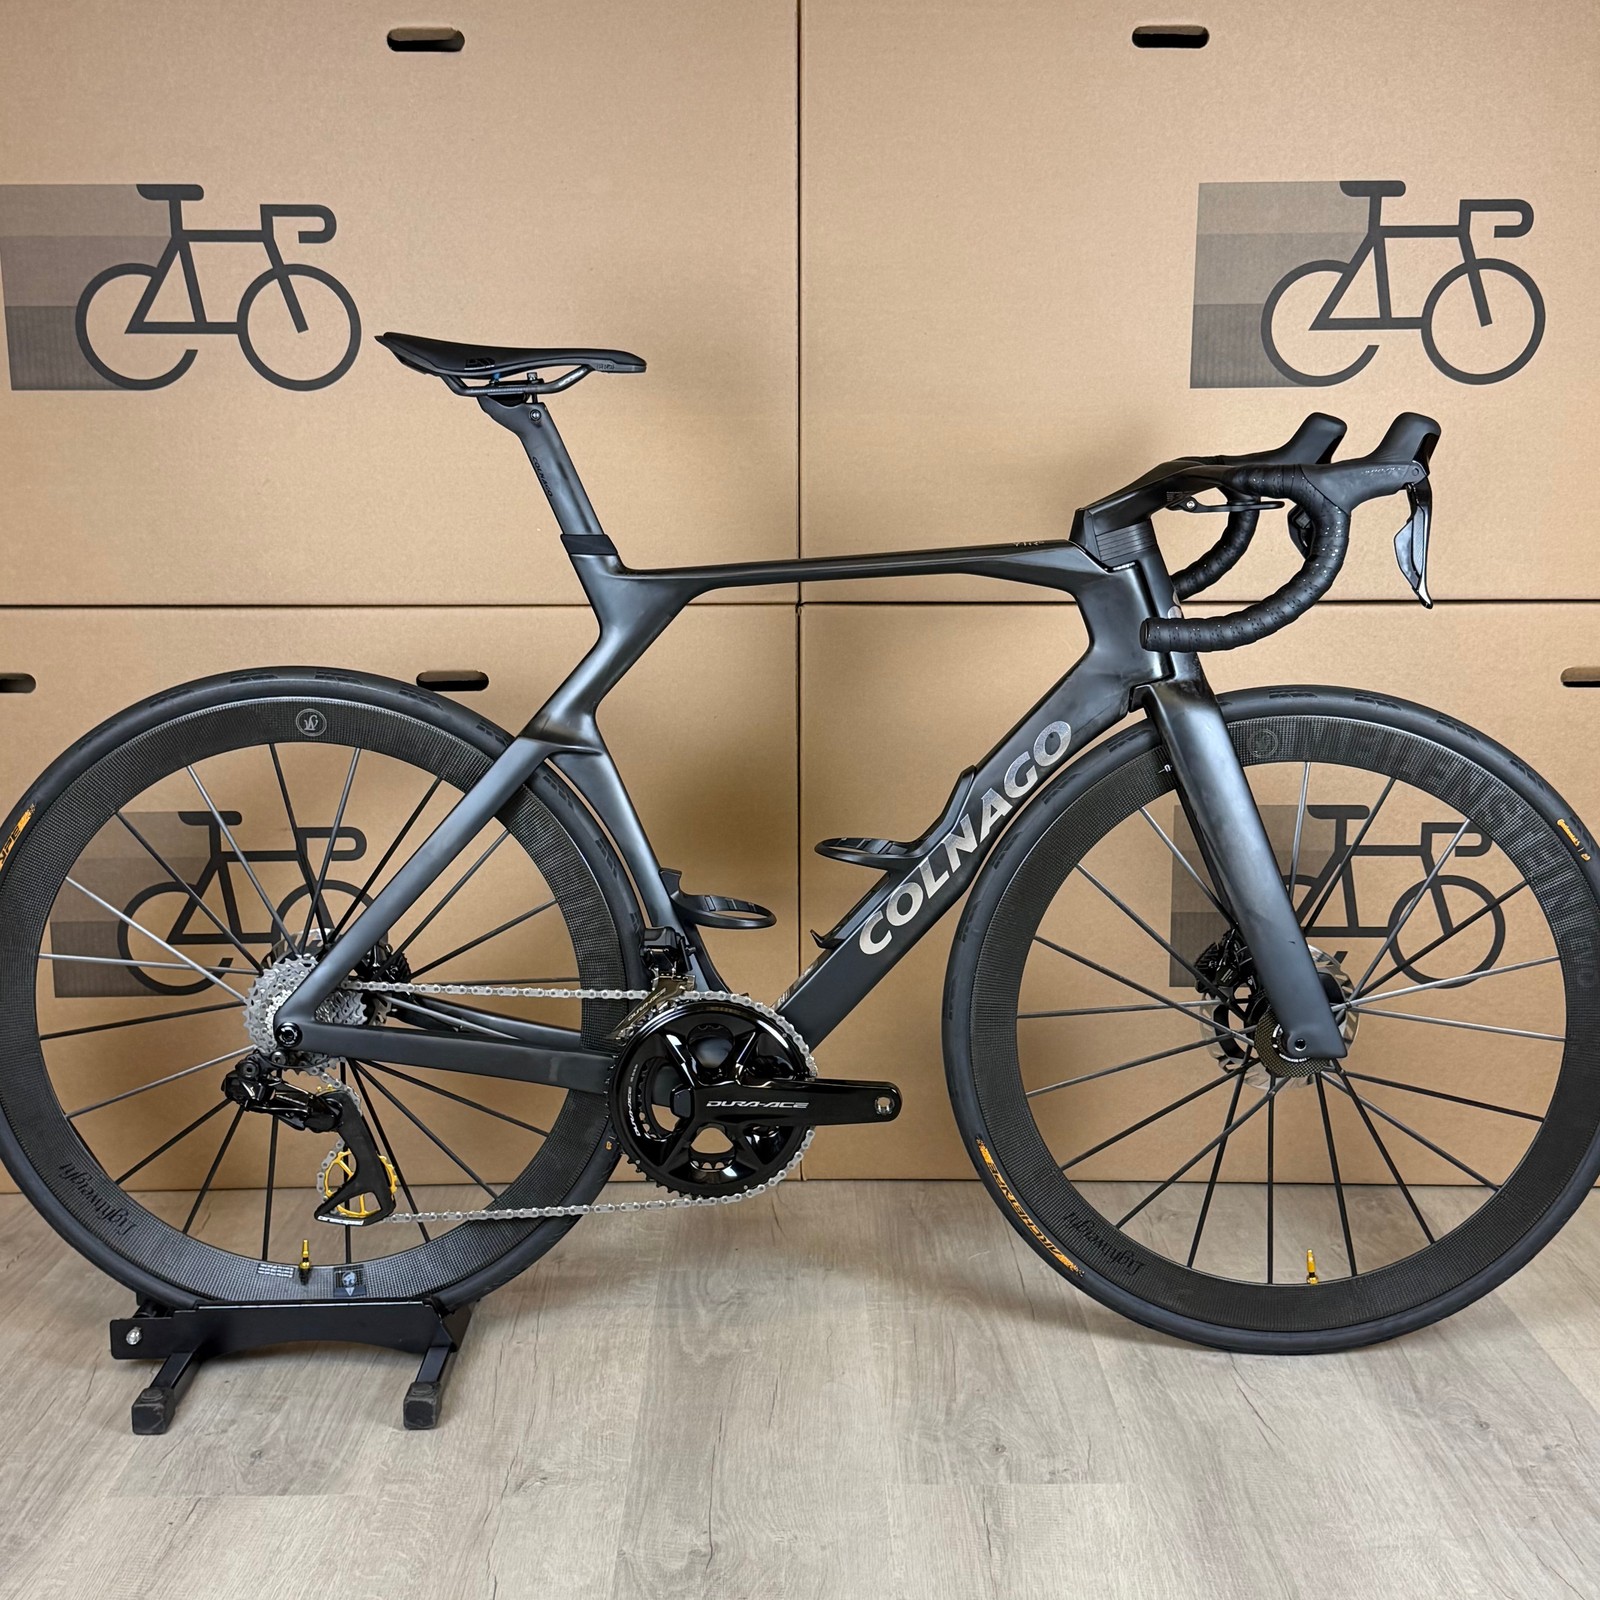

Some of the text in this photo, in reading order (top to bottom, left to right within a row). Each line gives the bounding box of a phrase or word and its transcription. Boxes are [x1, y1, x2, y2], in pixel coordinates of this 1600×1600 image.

[532, 456, 554, 497] COLNAGO
[858, 720, 1072, 956] COLNAGO
[706, 1100, 810, 1109] DURA-ACE
